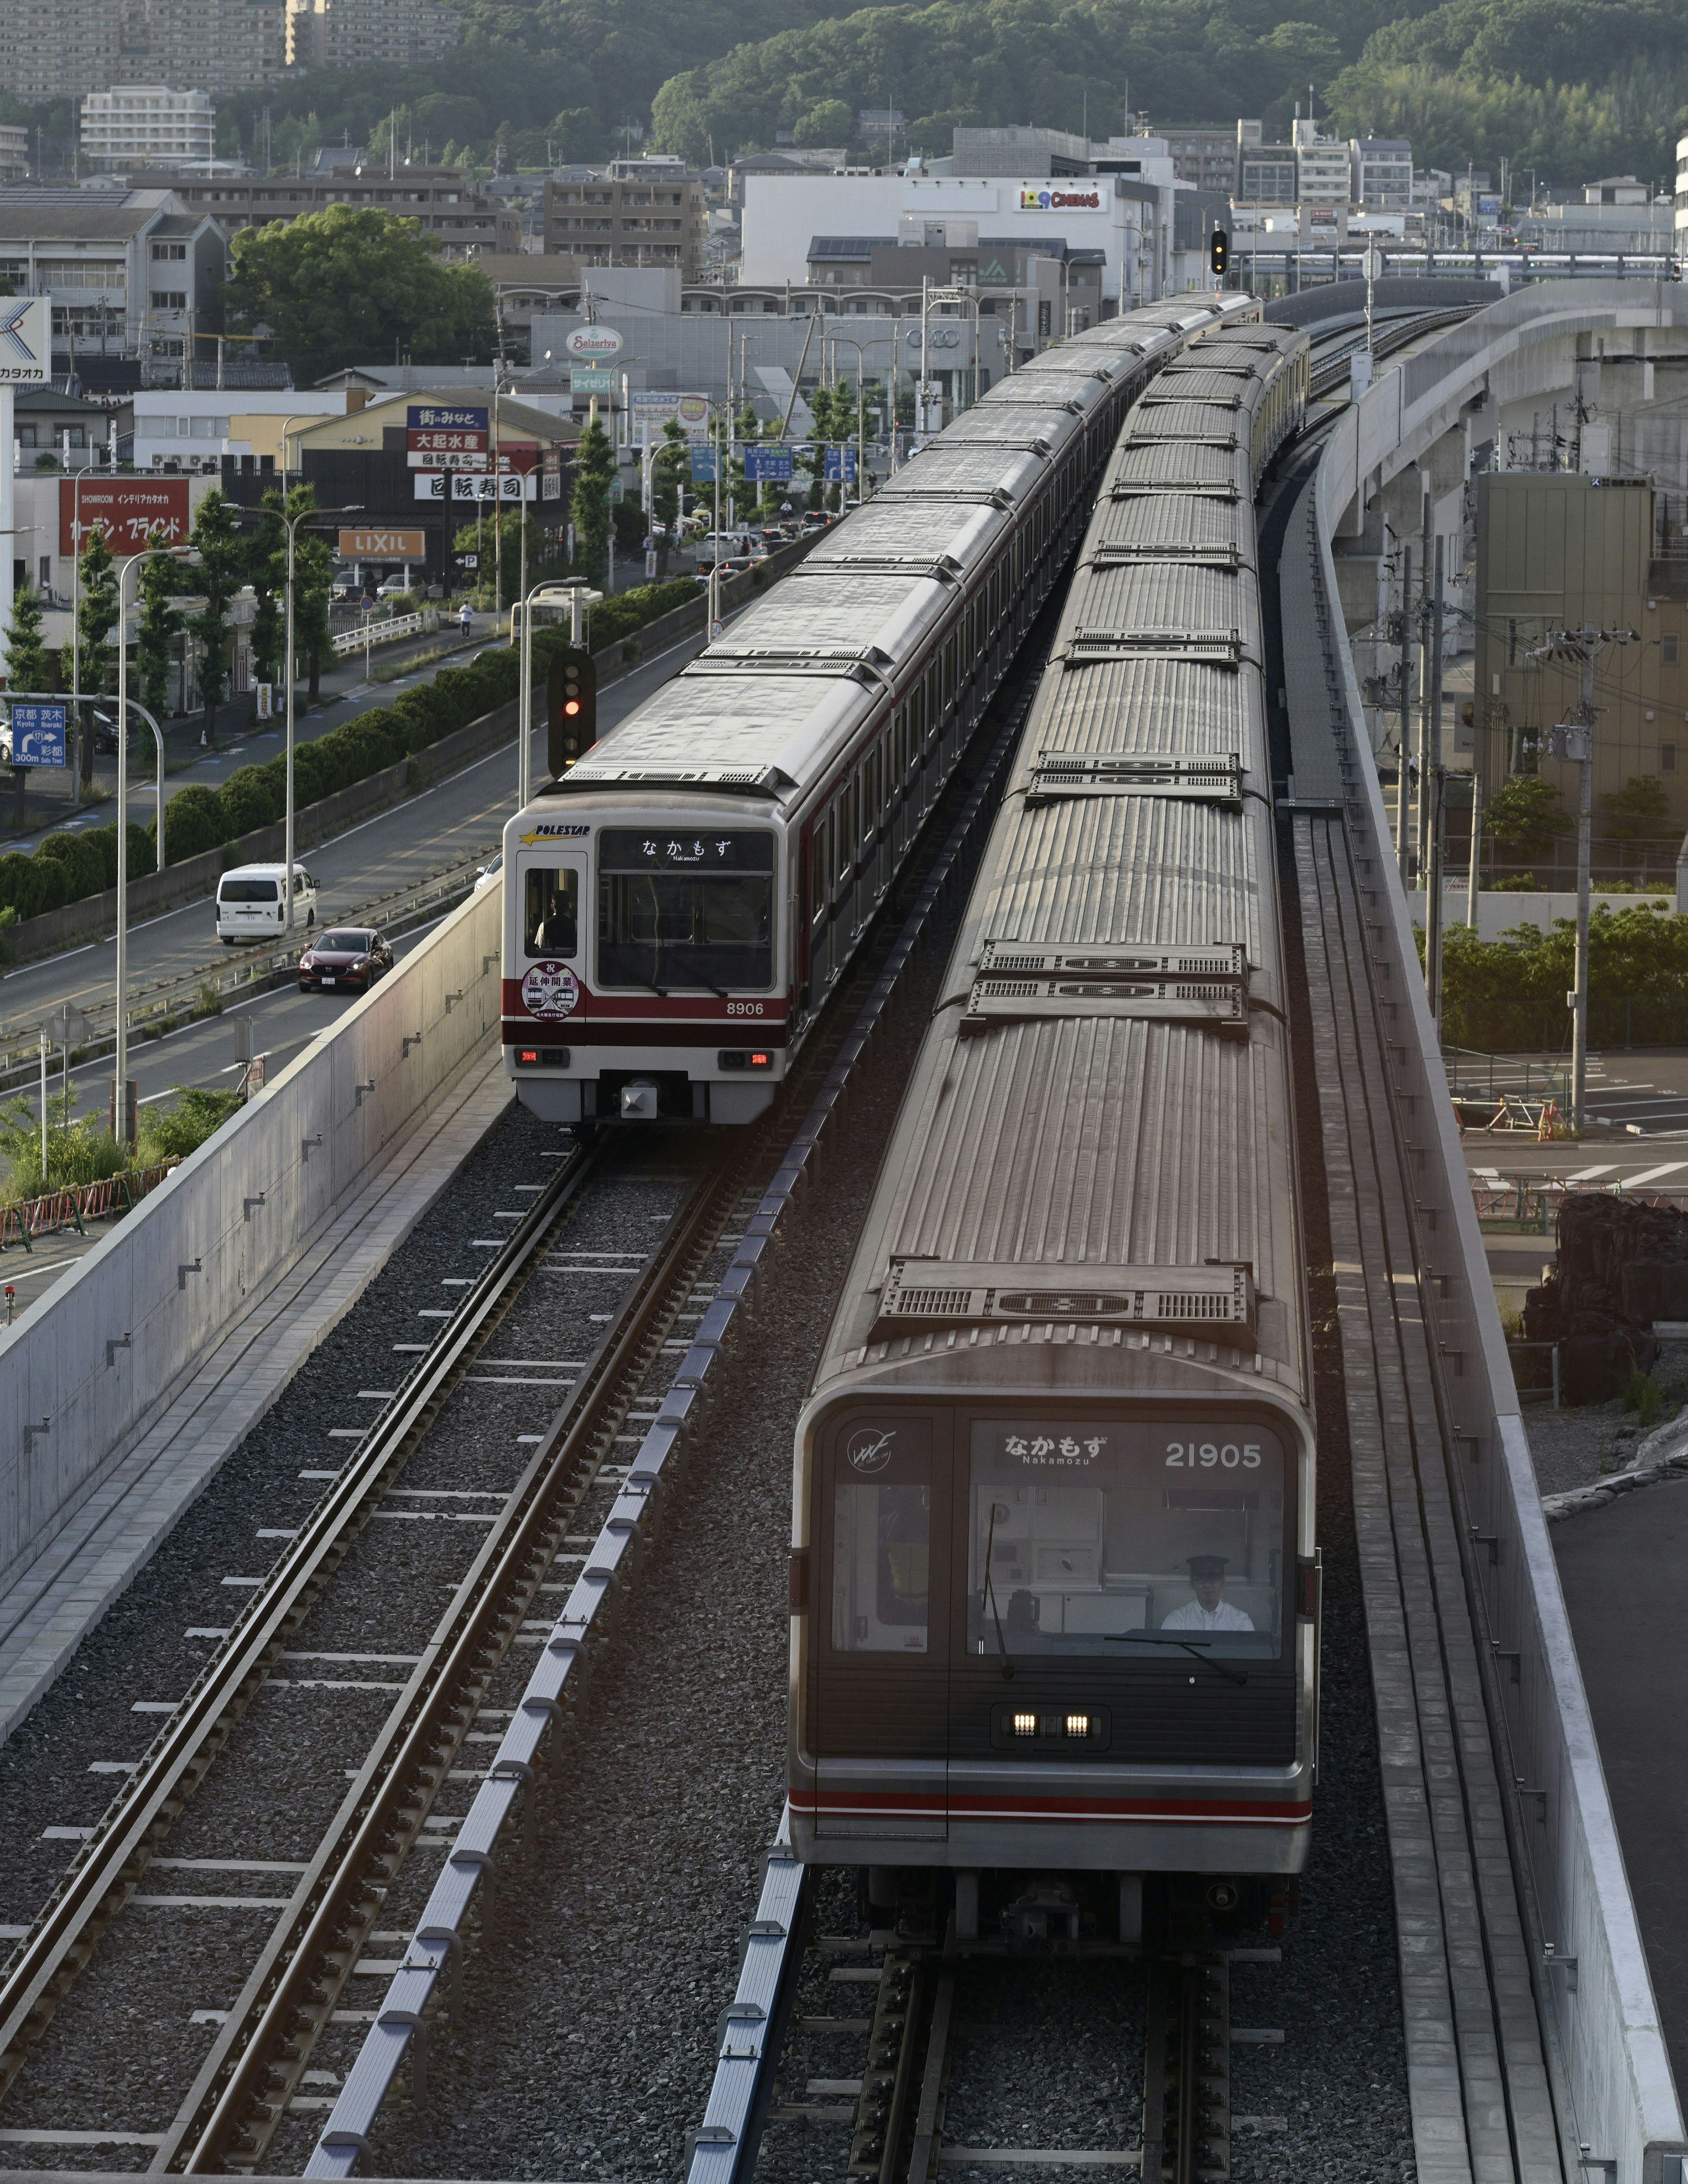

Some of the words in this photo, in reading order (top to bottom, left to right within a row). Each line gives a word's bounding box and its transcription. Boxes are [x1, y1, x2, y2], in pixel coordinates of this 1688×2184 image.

[1021, 191, 1051, 209] 109
[1051, 192, 1099, 208] CINEMAS
[573, 336, 616, 351] Saizeriya
[0, 368, 43, 378] カタオカ
[573, 378, 615, 388] サイゼリヤ
[419, 409, 475, 425] 街のみなと
[417, 434, 478, 449] 大起水産
[422, 454, 473, 465] 回転寿司
[431, 477, 520, 498] 回転寿司
[81, 495, 113, 504] SHOWROOM
[117, 494, 169, 504] インテリアカタオカ
[355, 534, 406, 552] LIXIL
[467, 556, 475, 566] P
[15, 709, 36, 720] 京都
[41, 710, 62, 720] 茨木
[41, 746, 62, 756] 彩都
[15, 754, 39, 762] 300m
[536, 825, 590, 835] POLESTAR
[643, 840, 731, 856] なかもず
[546, 963, 555, 973] 祝
[529, 976, 572, 987] 延伸開業
[727, 1003, 764, 1015] 8906
[1005, 1435, 1108, 1458] なかもず
[1022, 1455, 1089, 1466] Nakamozu
[1166, 1443, 1261, 1468] 21905
